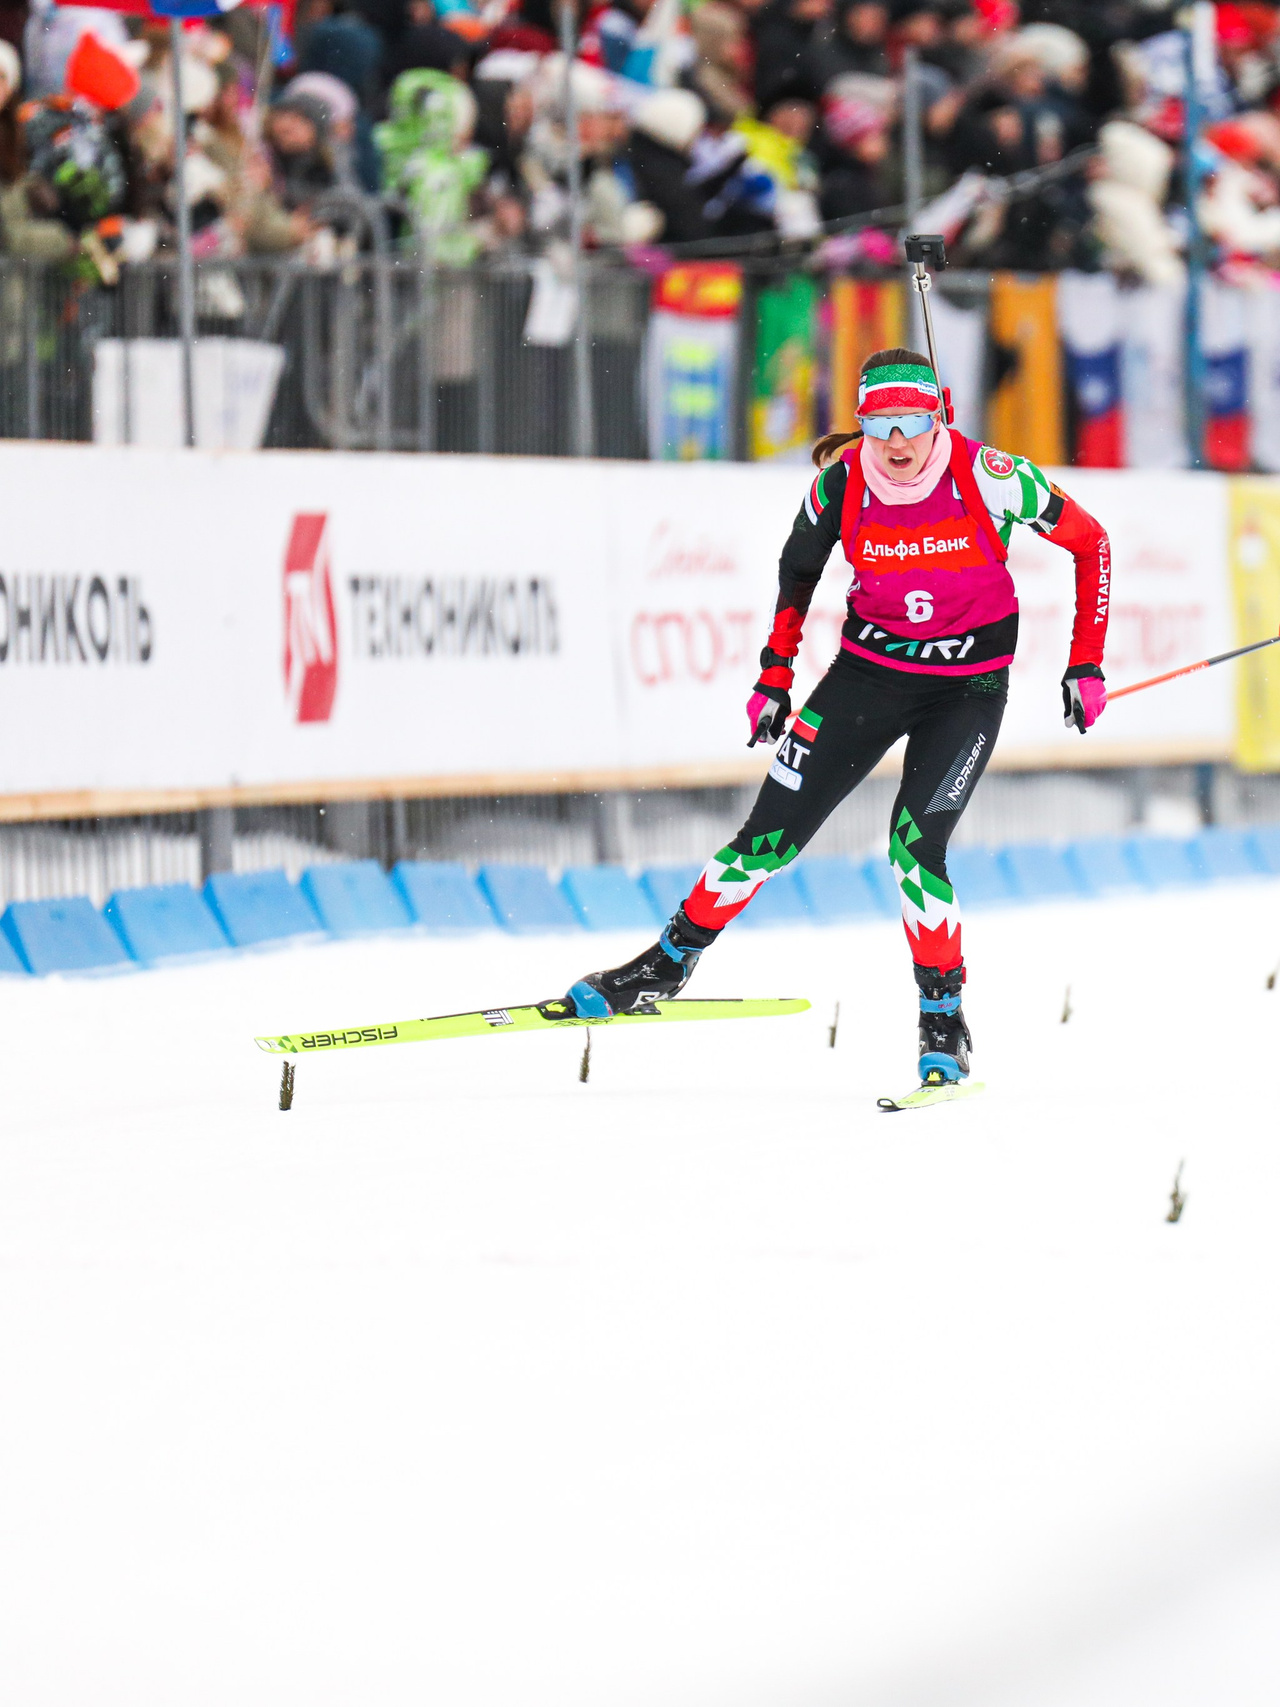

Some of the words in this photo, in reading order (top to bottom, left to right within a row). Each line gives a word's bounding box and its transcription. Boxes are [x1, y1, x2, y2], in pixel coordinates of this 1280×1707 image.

[863, 540, 920, 562] Альфа
[923, 536, 970, 555] Банк
[350, 575, 560, 656] ТЕХНОНИКОЛЬ
[904, 590, 934, 623] 6
[947, 732, 987, 802] NORDSKI
[300, 1025, 399, 1049] FISCHER
